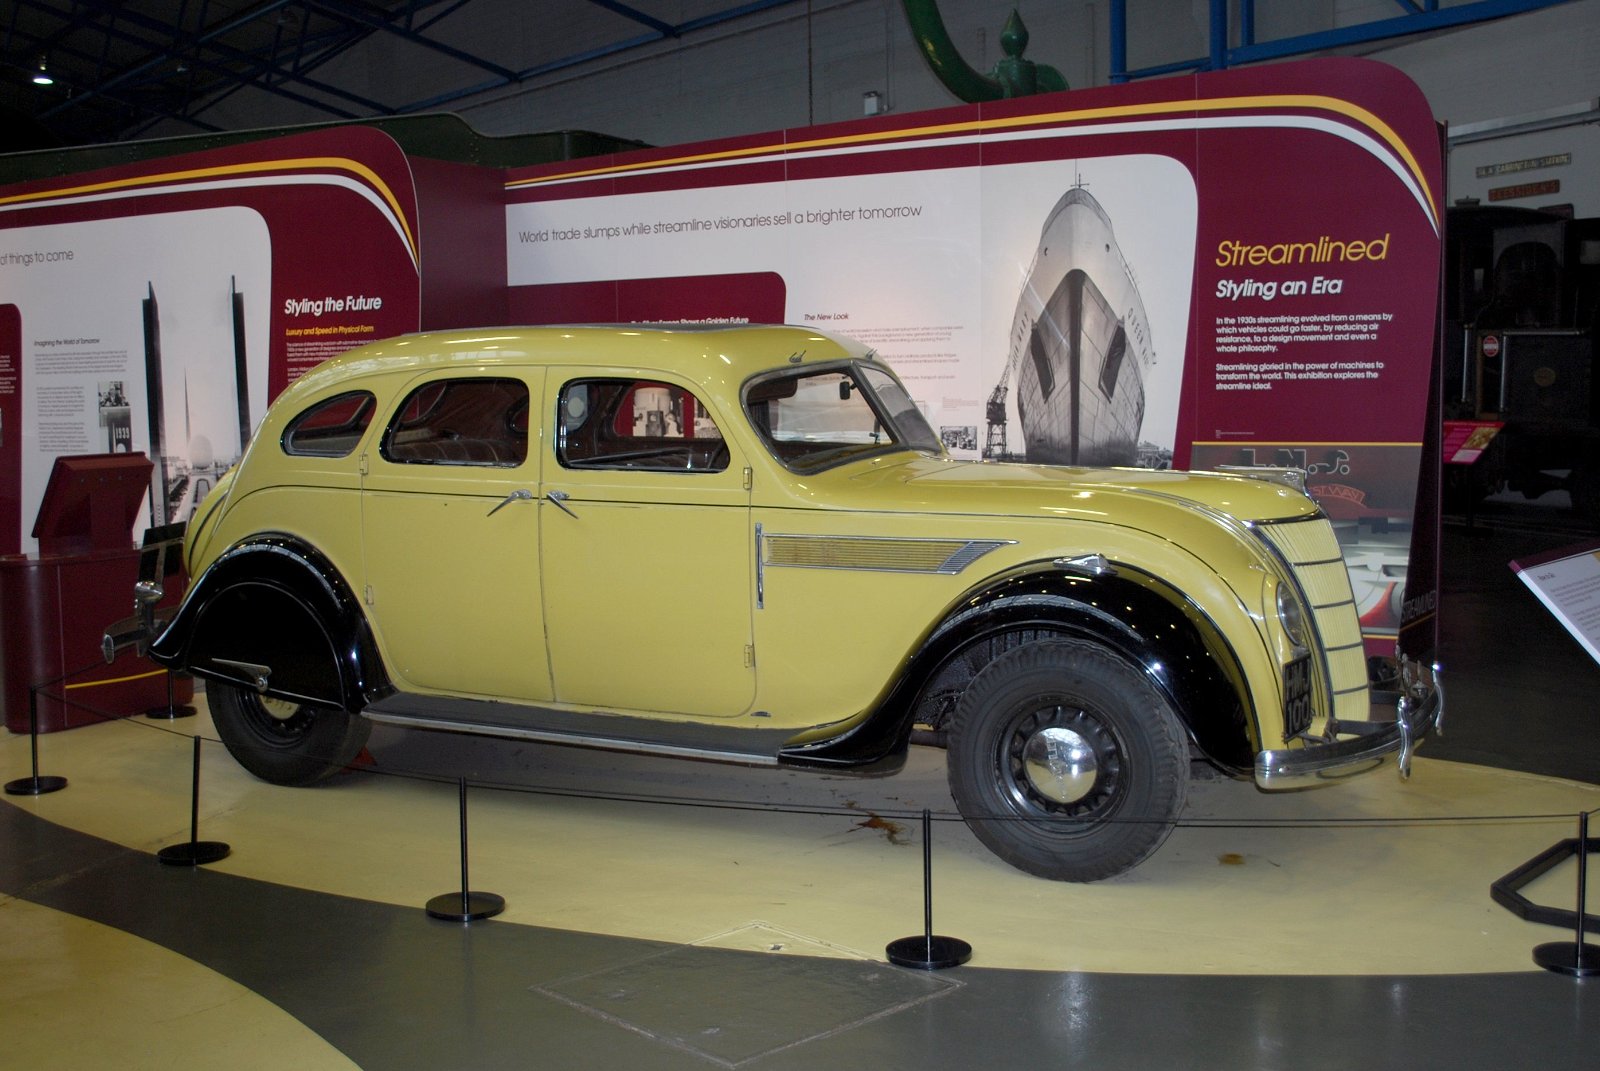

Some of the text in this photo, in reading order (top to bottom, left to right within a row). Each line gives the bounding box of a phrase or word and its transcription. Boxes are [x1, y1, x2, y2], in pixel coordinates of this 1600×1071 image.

[519, 205, 922, 243] World trade slumps while streamline visionaries sell a brighter tomorrow
[1215, 233, 1390, 267] Streamlined
[9, 253, 34, 267] things
[35, 251, 45, 263] to
[46, 250, 74, 262] come
[1215, 276, 1343, 301] Styling an Era
[284, 295, 382, 317] Styling the Future
[729, 316, 749, 325] Future
[804, 312, 849, 321] The New Look
[1216, 317, 1223, 325] In
[1224, 317, 1236, 325] the
[1237, 316, 1256, 324] 1930s
[1257, 315, 1300, 324] streamlining
[1382, 312, 1393, 322] by
[285, 324, 375, 337] Luxury and Speed in Physical Form
[1216, 322, 1379, 334] which vehicles could go faster, by reducing air
[1216, 335, 1253, 344] resistance,
[1268, 335, 1293, 344] design
[1293, 333, 1333, 342] movement
[1334, 333, 1350, 341] and
[1238, 344, 1279, 353] philosophy.
[1216, 363, 1259, 372] Streamlining
[1259, 362, 1285, 372] gloried
[1292, 362, 1305, 370] the
[1305, 362, 1329, 371] power
[1330, 361, 1338, 369] of
[1338, 361, 1375, 369] machines
[1375, 361, 1385, 369] to
[1216, 373, 1249, 381] transform
[1261, 372, 1283, 380] world.
[1284, 372, 1298, 380] This
[1297, 371, 1333, 380] exhibition
[1333, 371, 1366, 380] explores
[1366, 371, 1379, 379] the
[1216, 382, 1272, 390] streamline ideal.
[115, 427, 130, 439] 1939
[1287, 693, 1310, 736] 100
